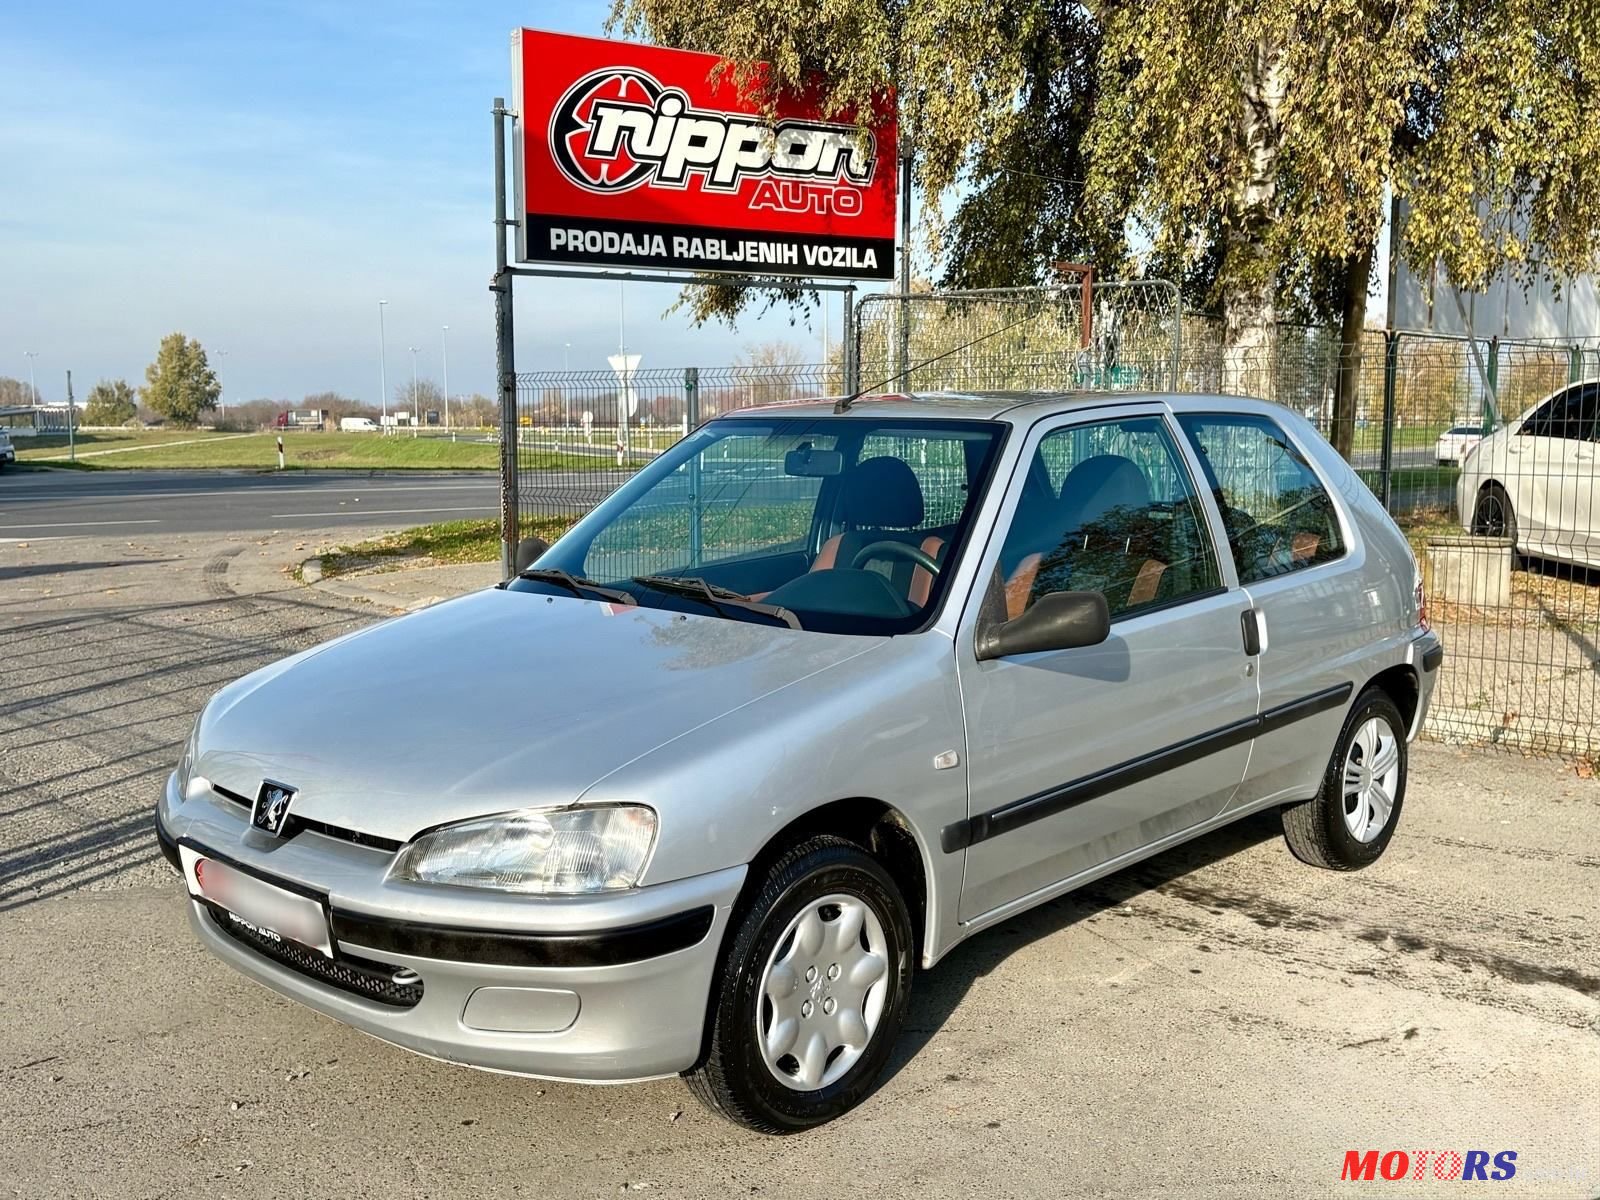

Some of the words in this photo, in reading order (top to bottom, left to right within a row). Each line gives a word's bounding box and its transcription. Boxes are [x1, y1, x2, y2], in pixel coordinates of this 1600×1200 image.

[748, 182, 862, 217] AUTO
[550, 228, 667, 257] PRODAJA
[673, 237, 798, 265] RABLJENIH
[803, 245, 878, 269] VOZILA
[258, 927, 281, 942] AUTO
